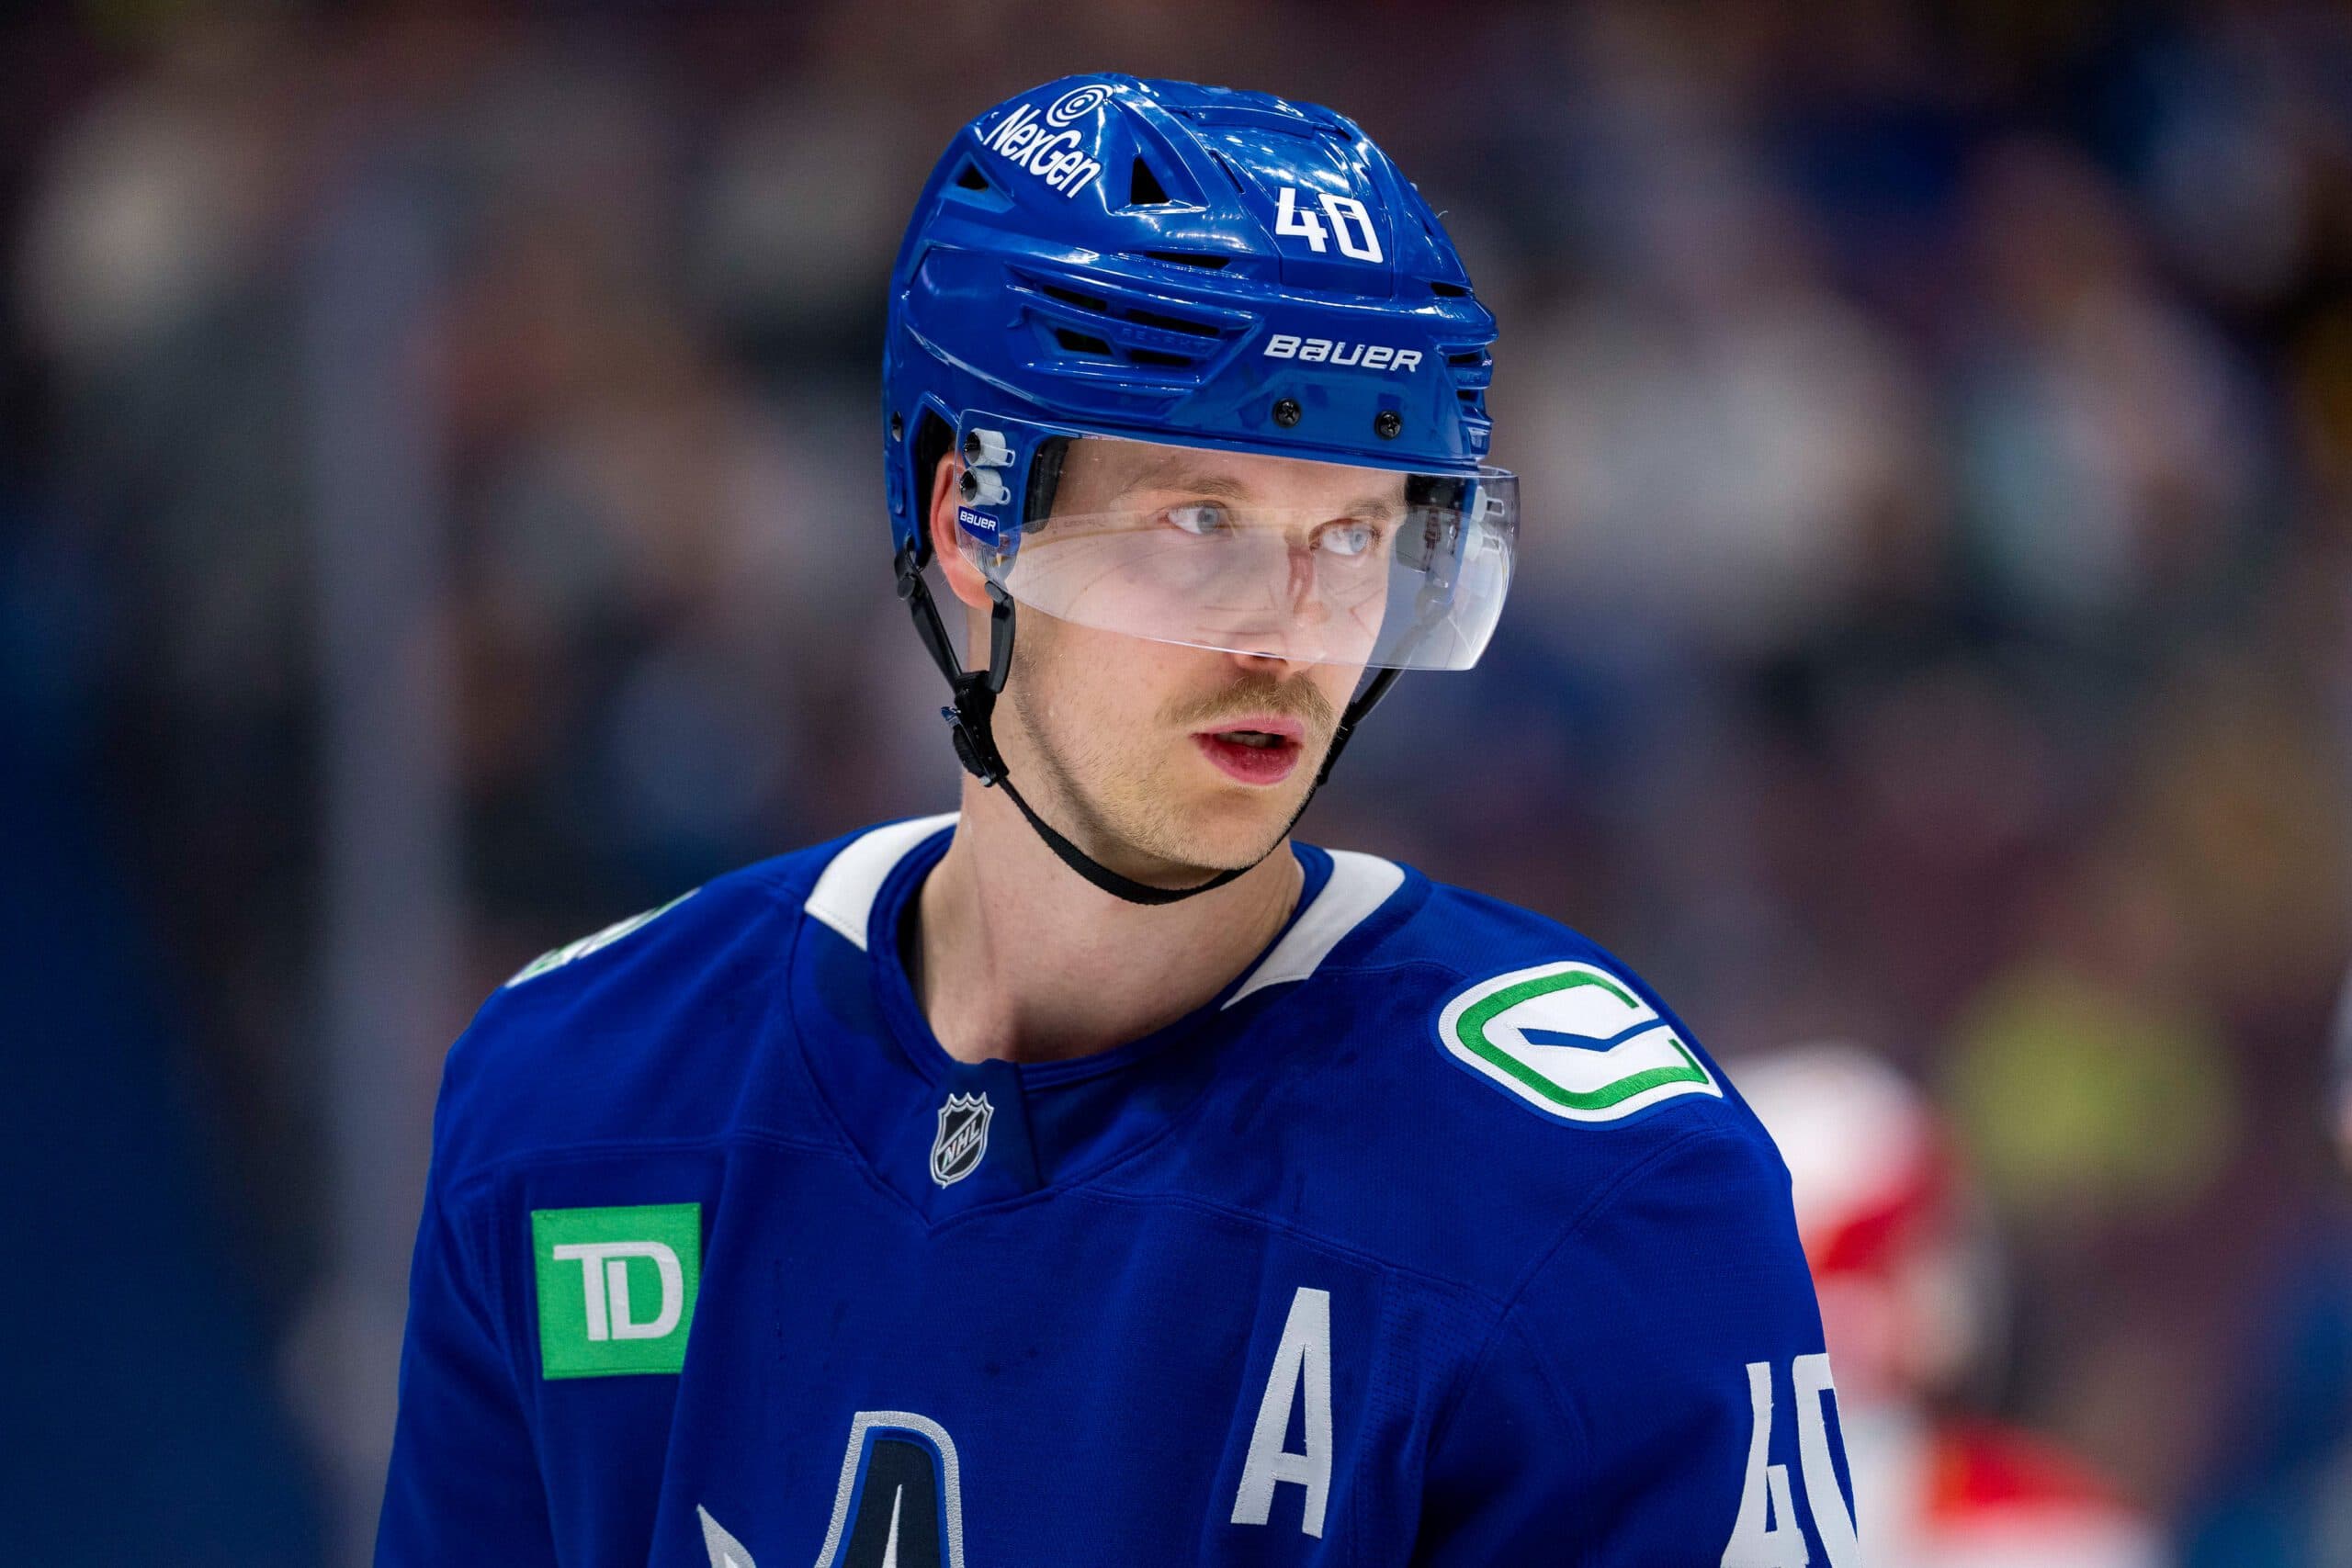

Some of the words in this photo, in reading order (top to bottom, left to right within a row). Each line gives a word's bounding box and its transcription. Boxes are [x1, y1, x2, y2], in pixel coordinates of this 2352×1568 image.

[982, 103, 1102, 198] NexGen
[1275, 186, 1384, 264] 40
[942, 1120, 980, 1170] NHL
[553, 1241, 684, 1341] TD
[1230, 1286, 1332, 1540] A
